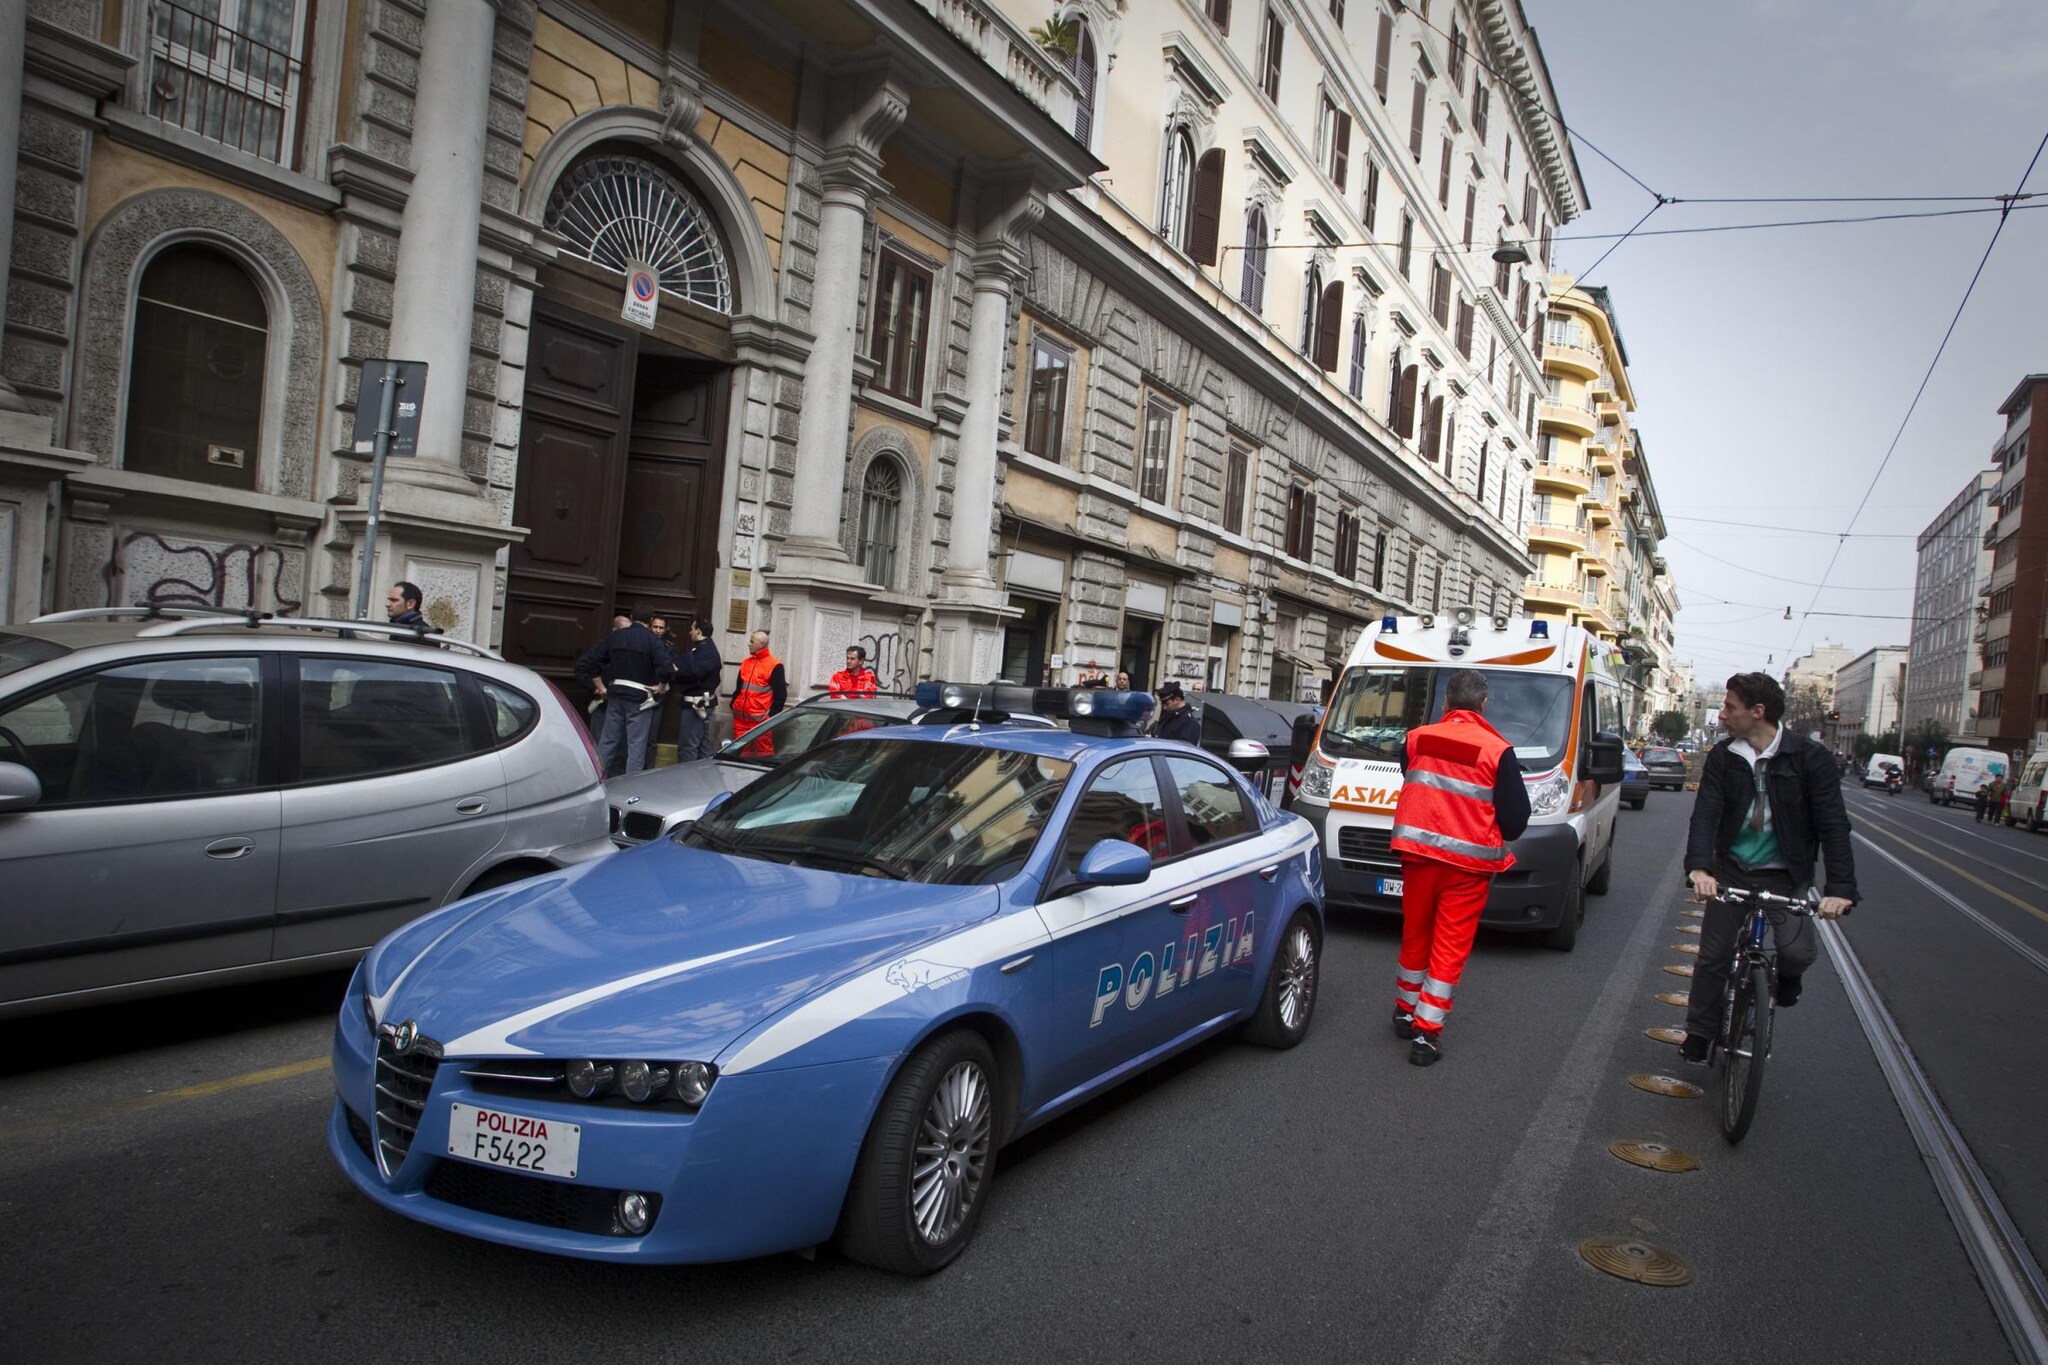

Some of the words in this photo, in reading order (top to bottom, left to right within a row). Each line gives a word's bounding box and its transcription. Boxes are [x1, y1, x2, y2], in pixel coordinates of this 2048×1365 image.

[1089, 911, 1255, 1029] POLIZIA
[476, 1110, 548, 1140] POLIZIA
[474, 1132, 546, 1171] F5422
